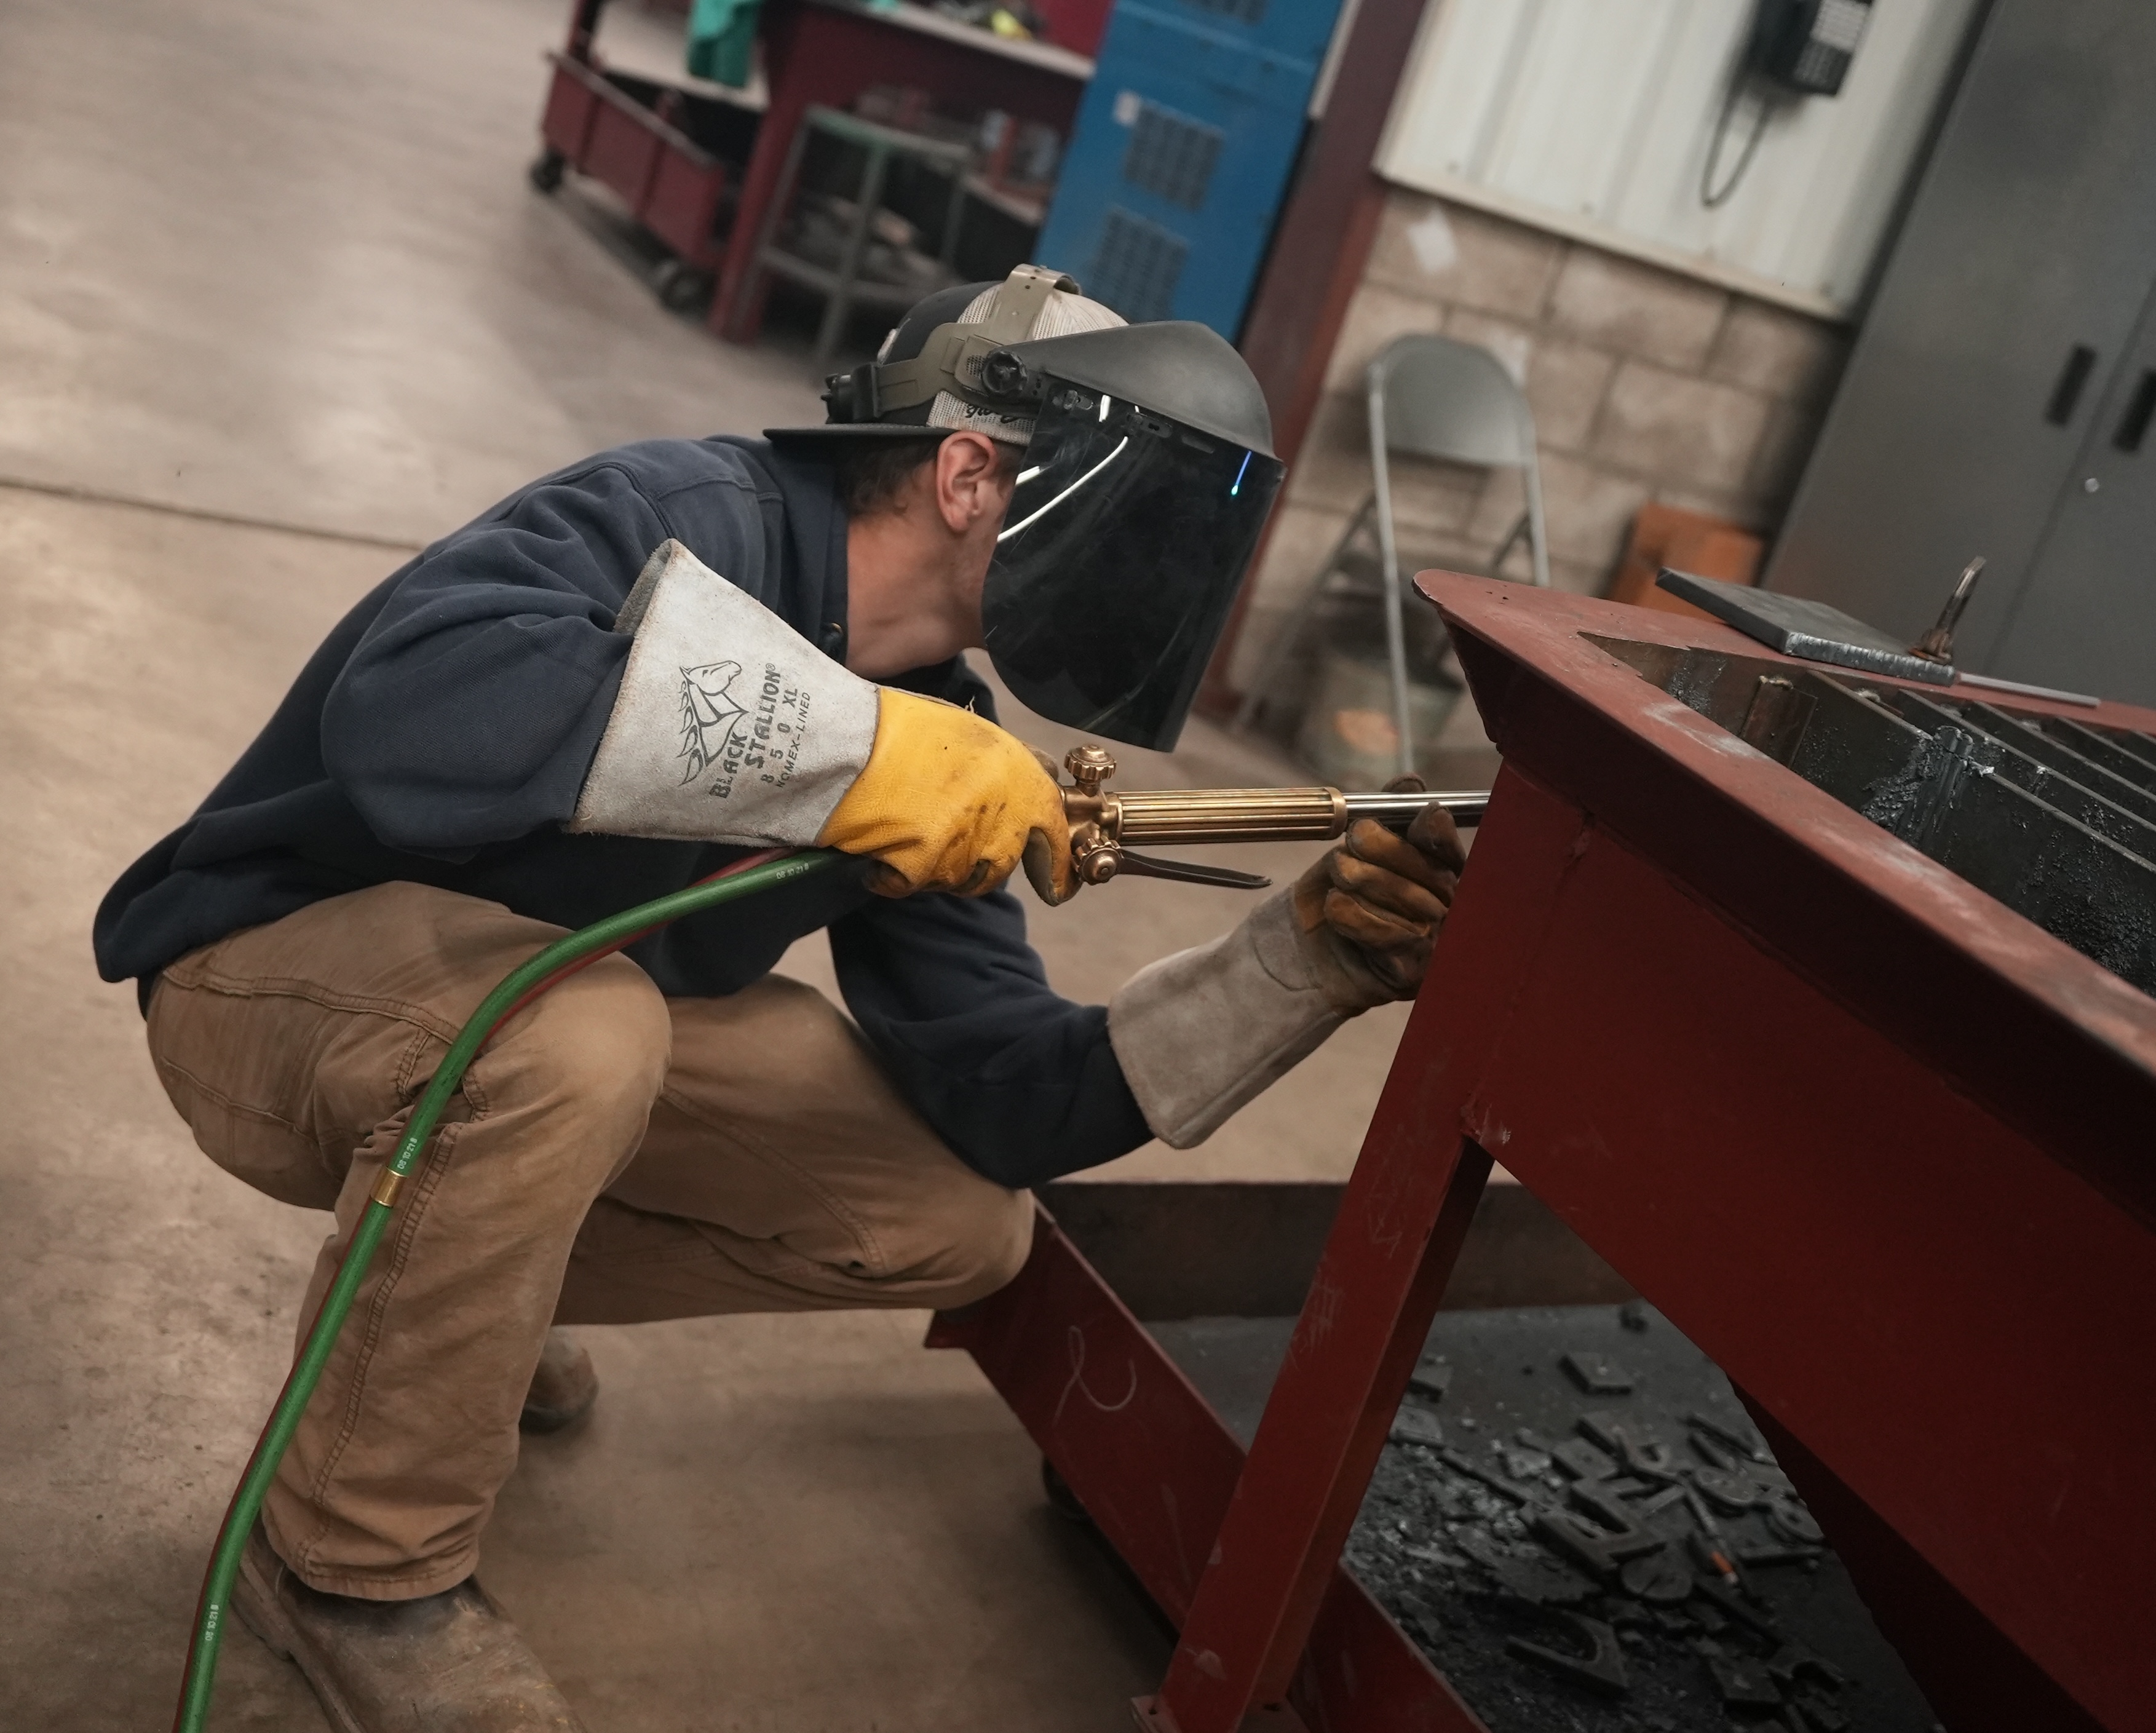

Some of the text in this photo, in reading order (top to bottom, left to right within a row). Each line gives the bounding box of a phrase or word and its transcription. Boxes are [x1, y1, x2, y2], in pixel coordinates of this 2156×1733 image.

[782, 688, 798, 708] XL
[709, 732, 748, 798] BLACK
[775, 692, 810, 788] NOMEX-LINED
